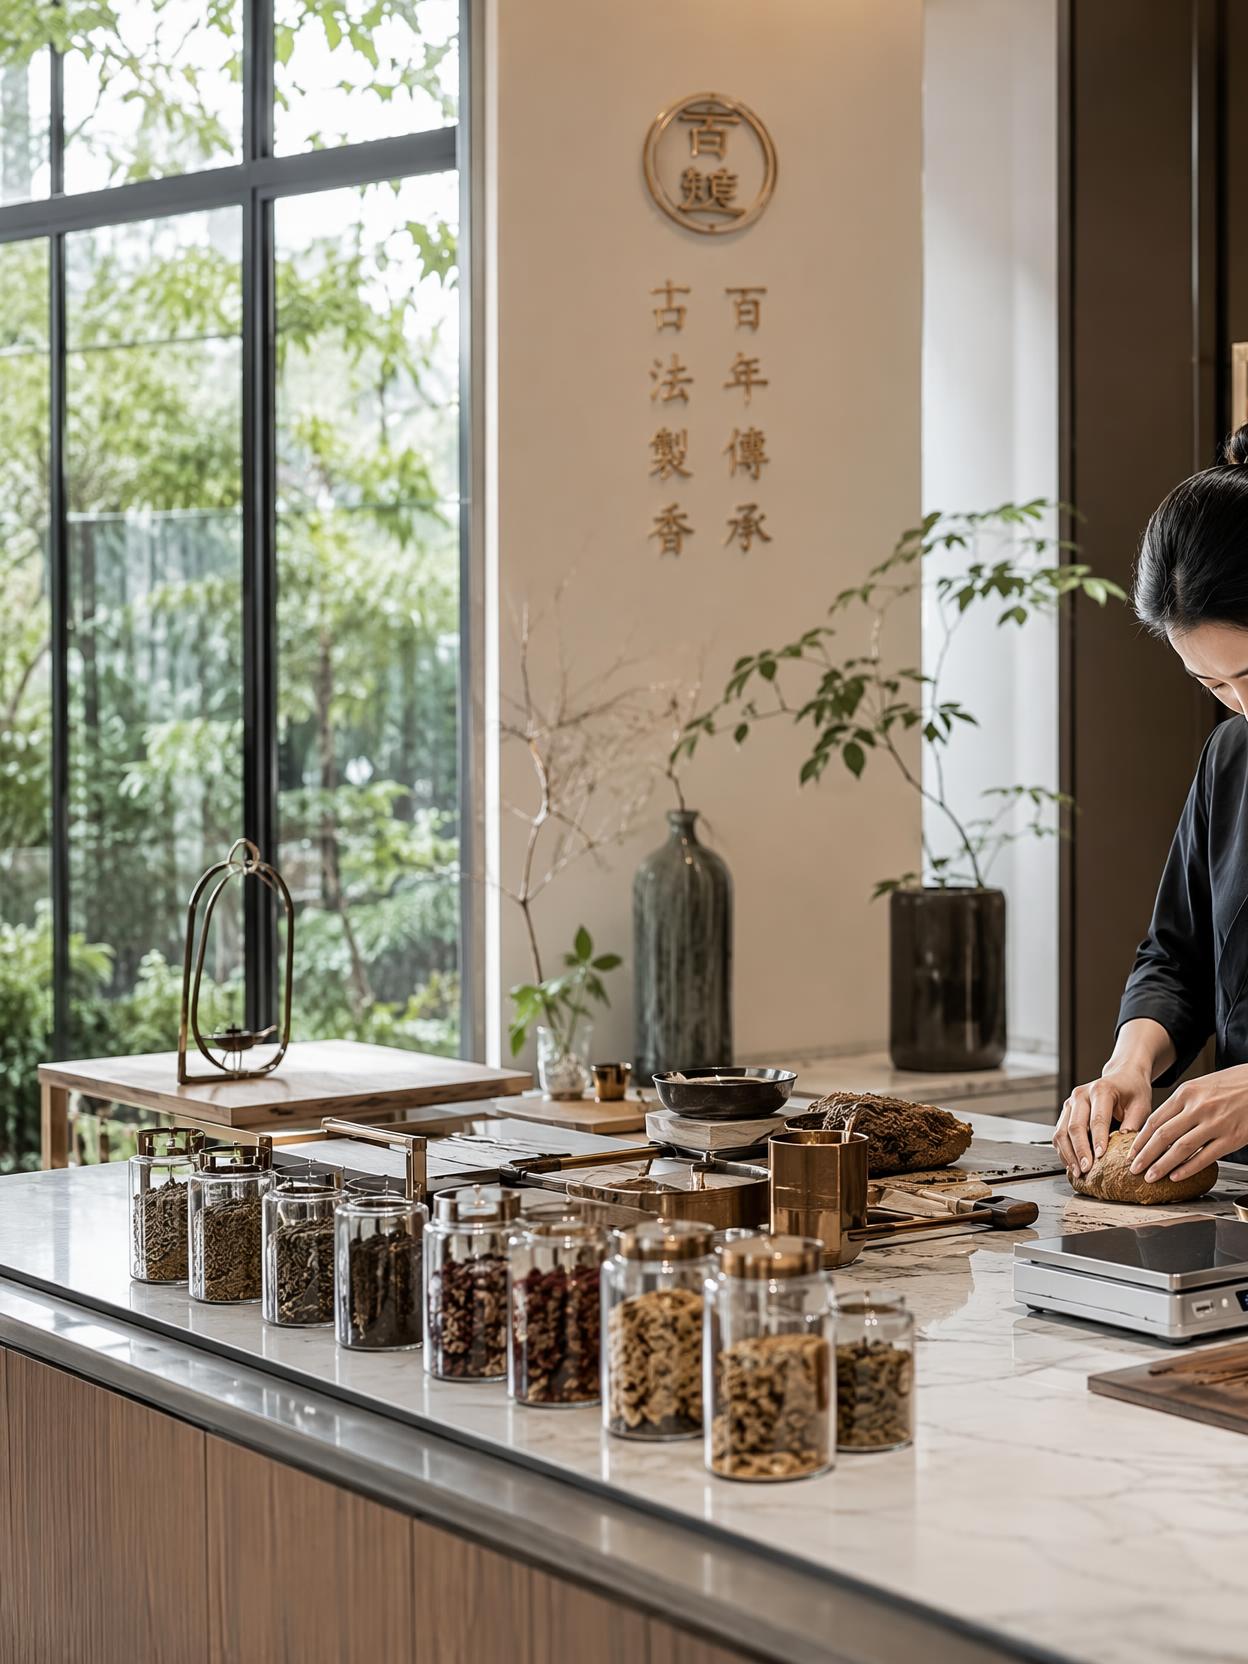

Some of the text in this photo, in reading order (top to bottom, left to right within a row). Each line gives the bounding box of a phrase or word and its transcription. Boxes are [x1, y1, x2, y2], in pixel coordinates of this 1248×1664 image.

[648, 279, 695, 556] 古法製香
[723, 284, 771, 553] 百年傳承
